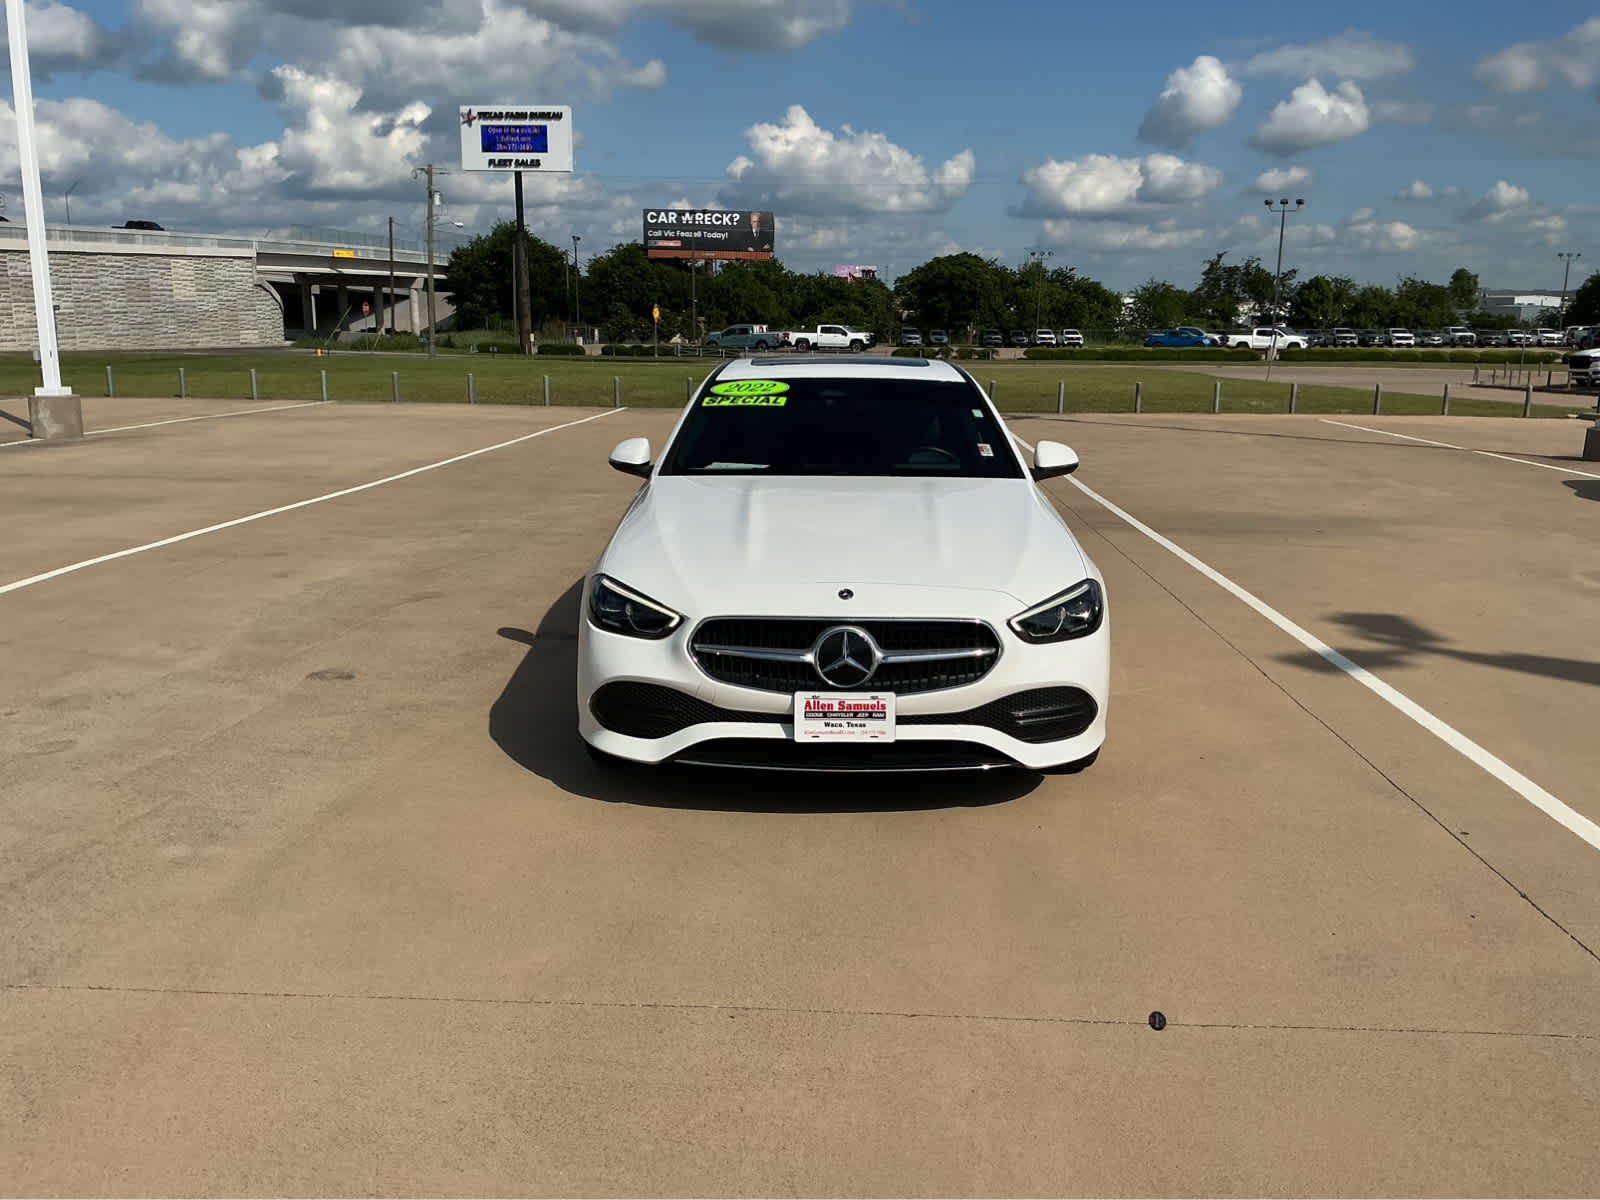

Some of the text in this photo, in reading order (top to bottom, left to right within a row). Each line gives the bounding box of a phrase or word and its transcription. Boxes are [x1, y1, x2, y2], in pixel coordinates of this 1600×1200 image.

[477, 112, 562, 121] TEXAS FARM BUREAU
[488, 159, 541, 168] FLEET SALES
[647, 211, 740, 225] CAR WRECK?
[703, 231, 728, 239] Today!
[723, 383, 777, 393] 2022
[804, 700, 887, 711] Allen Samuels
